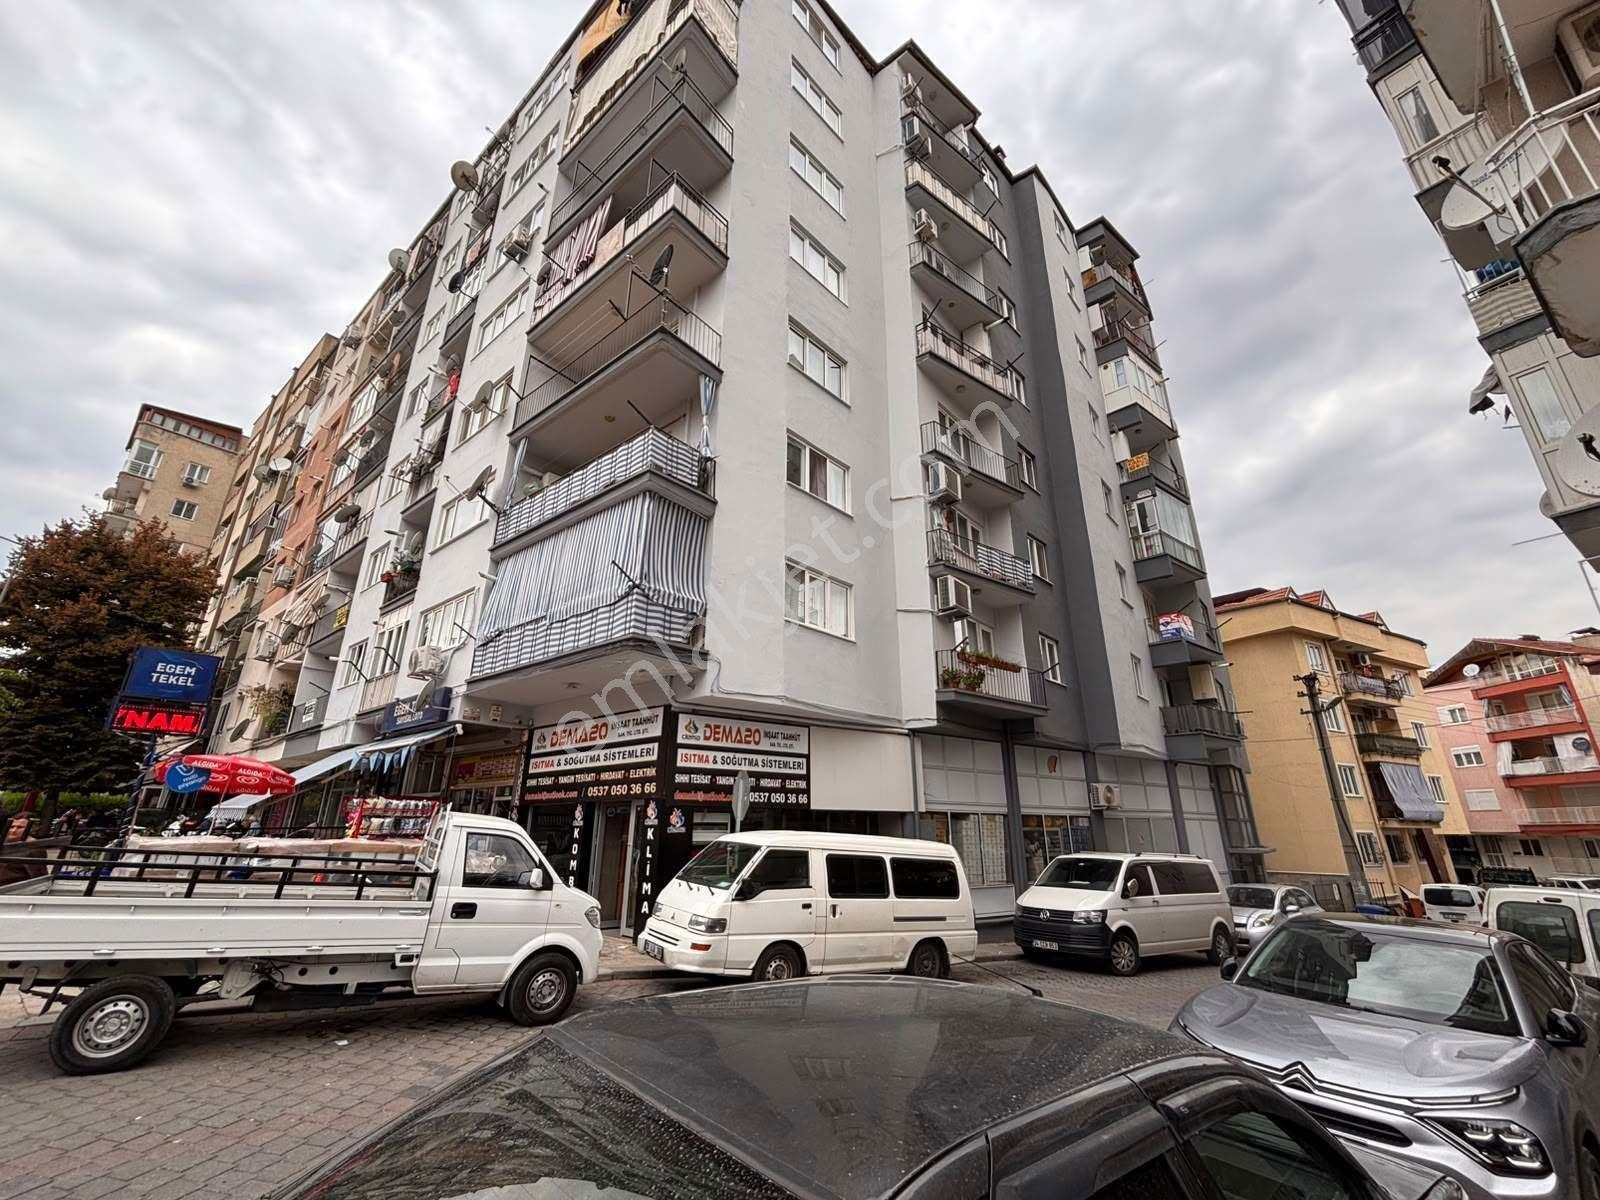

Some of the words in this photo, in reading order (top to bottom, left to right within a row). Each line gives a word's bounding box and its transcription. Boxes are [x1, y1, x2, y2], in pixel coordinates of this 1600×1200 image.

[155, 662, 196, 676] EGEM
[151, 672, 195, 686] TEKEL
[549, 721, 609, 748] DEMA20
[703, 723, 761, 746] DEMA20
[191, 759, 219, 769] ALGIDA
[556, 757, 562, 768] &
[603, 746, 656, 762] SİSTEMLERİ
[680, 752, 710, 764] ISITMA
[712, 756, 718, 765] &
[720, 754, 759, 768] SOĞUTMA
[760, 756, 804, 771] SİSTEMLERİ
[237, 767, 263, 777] ALGIDA
[630, 766, 657, 778] ELEKTRİK
[588, 785, 609, 797] 0537
[611, 784, 628, 796] 050
[630, 783, 642, 795] 36
[644, 782, 657, 794] 66
[749, 791, 770, 802] 0537
[770, 792, 785, 804] 050
[787, 793, 797, 804] 36
[798, 793, 808, 804] 66
[641, 827, 654, 914] KLİMA
